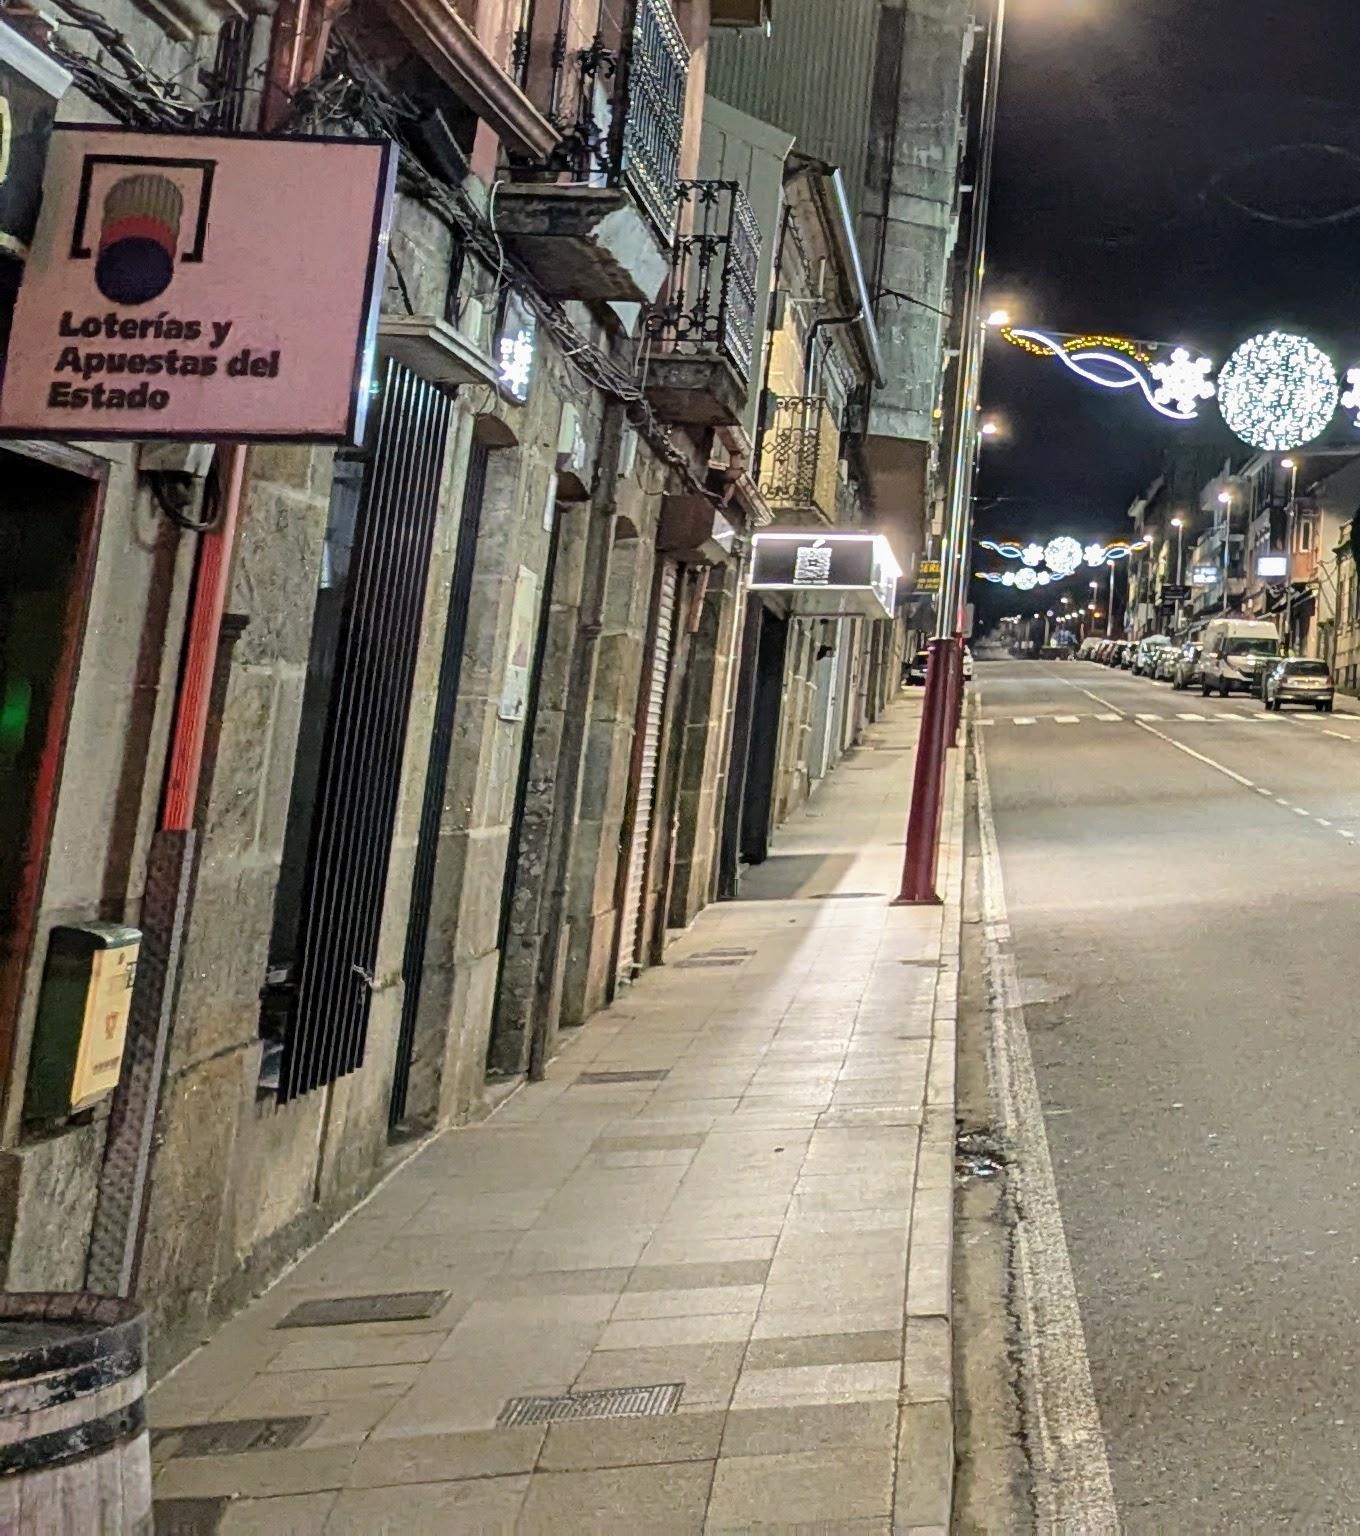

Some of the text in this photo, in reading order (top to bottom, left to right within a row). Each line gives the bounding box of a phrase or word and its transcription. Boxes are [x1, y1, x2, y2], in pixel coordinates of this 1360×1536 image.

[58, 310, 232, 348] Loterías y
[54, 346, 281, 381] Apuestas del
[47, 381, 170, 411] Estado
